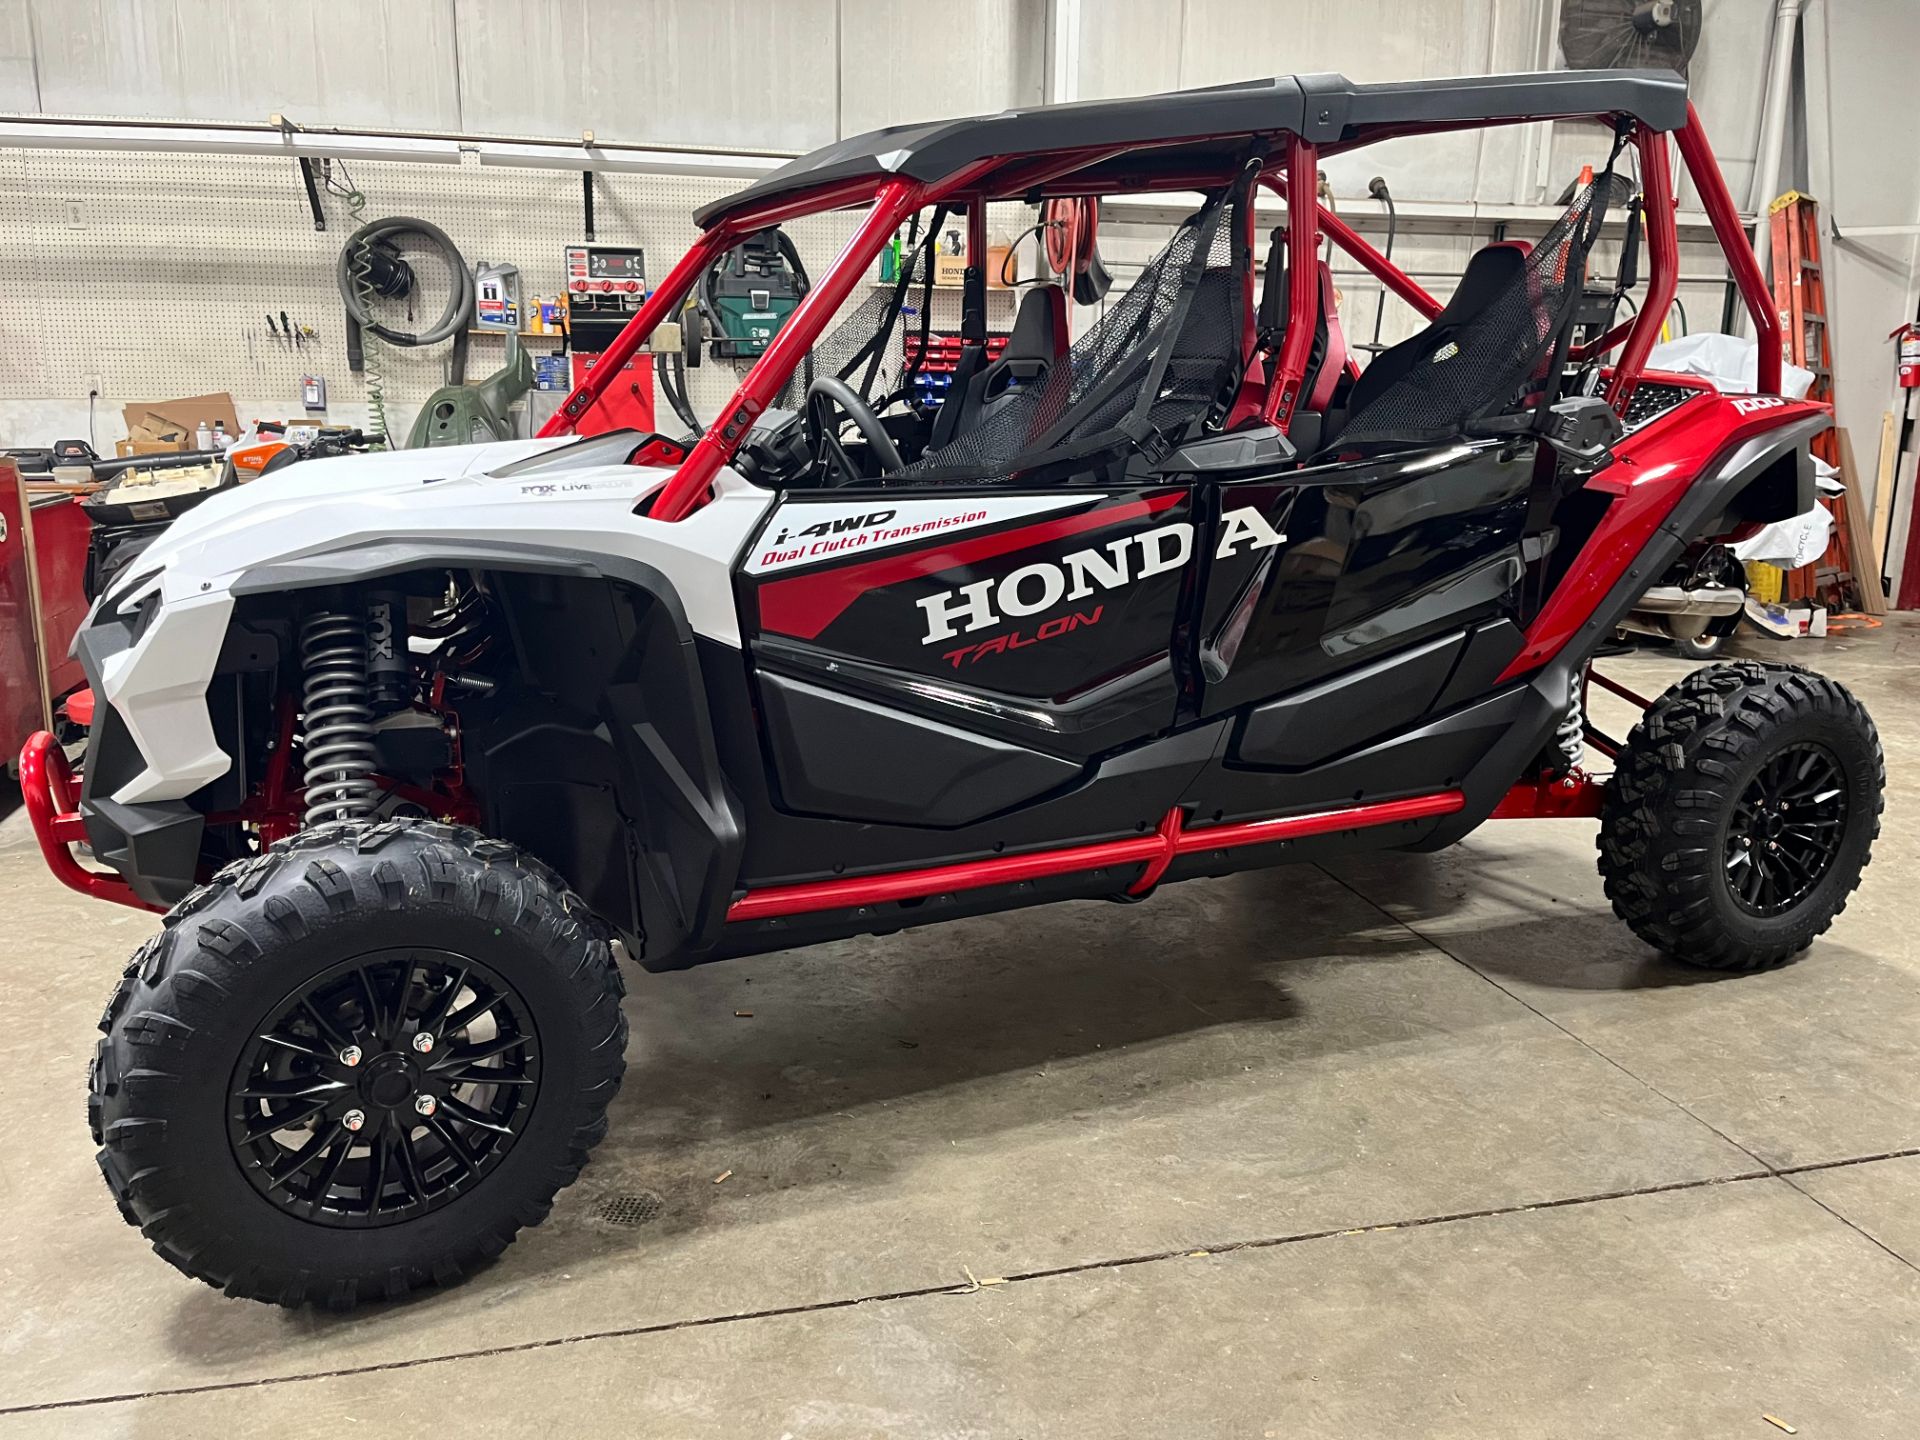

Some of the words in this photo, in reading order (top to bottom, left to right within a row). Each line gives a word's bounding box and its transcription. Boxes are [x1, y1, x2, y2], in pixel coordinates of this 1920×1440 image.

[1730, 397, 1785, 416] 1000
[761, 546, 806, 566] Dual
[809, 533, 868, 556] Clutch
[872, 510, 988, 543] Transmission
[774, 509, 897, 546] i-4WD
[368, 603, 394, 662] FOX
[942, 605, 1104, 669] TALON
